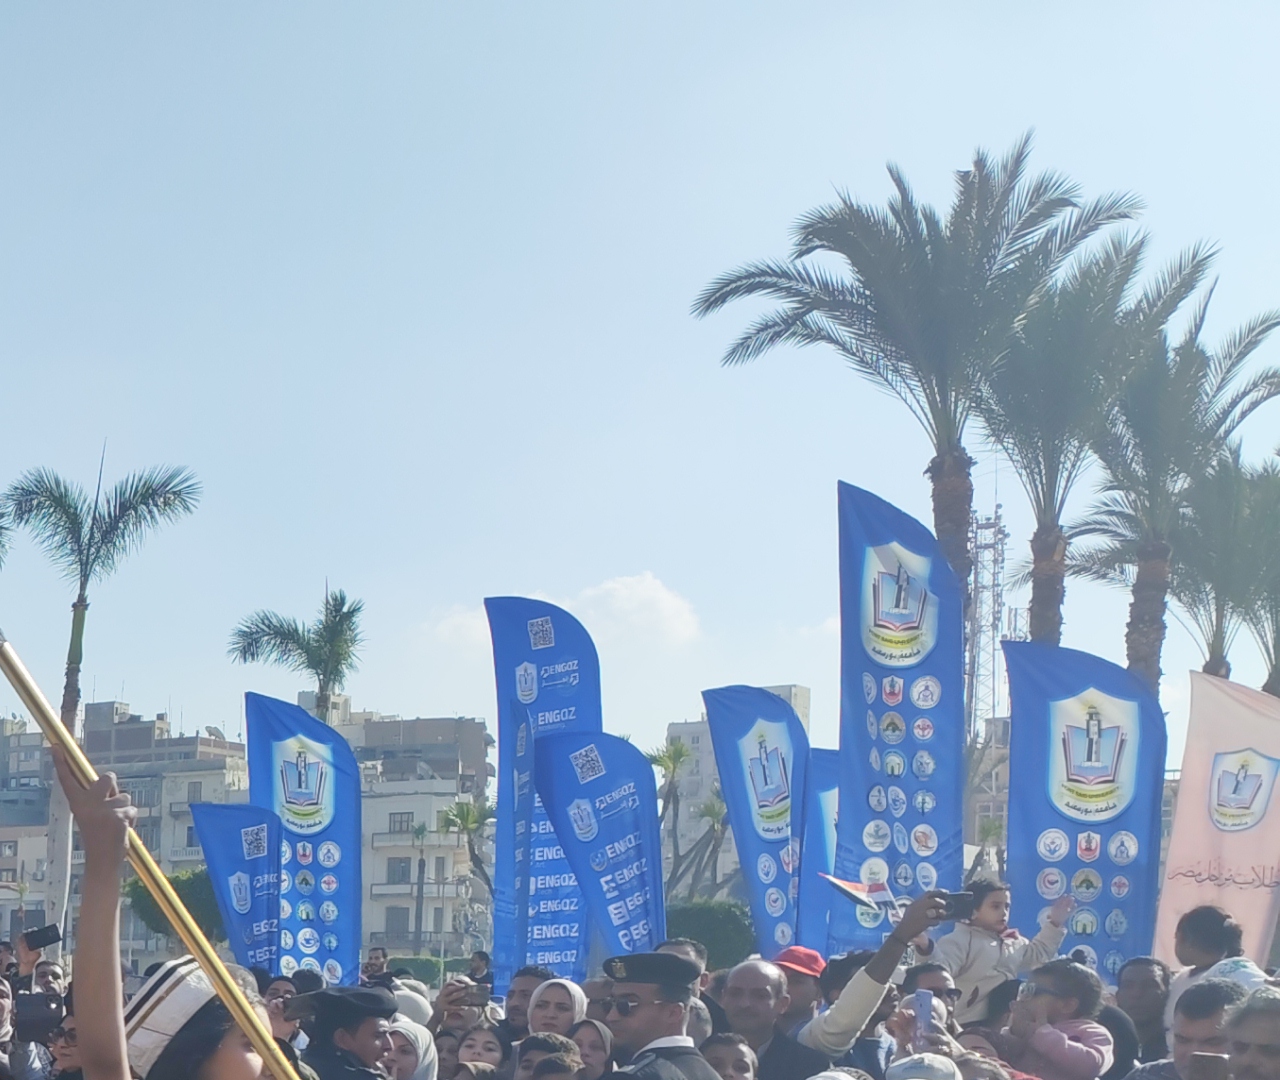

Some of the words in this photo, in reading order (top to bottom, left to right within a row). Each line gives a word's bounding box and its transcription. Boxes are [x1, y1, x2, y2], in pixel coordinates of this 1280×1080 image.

[538, 707, 576, 725] ENGOZ
[537, 873, 578, 889] ENGOZ
[540, 898, 579, 913] ENGOZ
[533, 923, 579, 939] ENGOZ
[537, 949, 577, 965] ENGOZ
